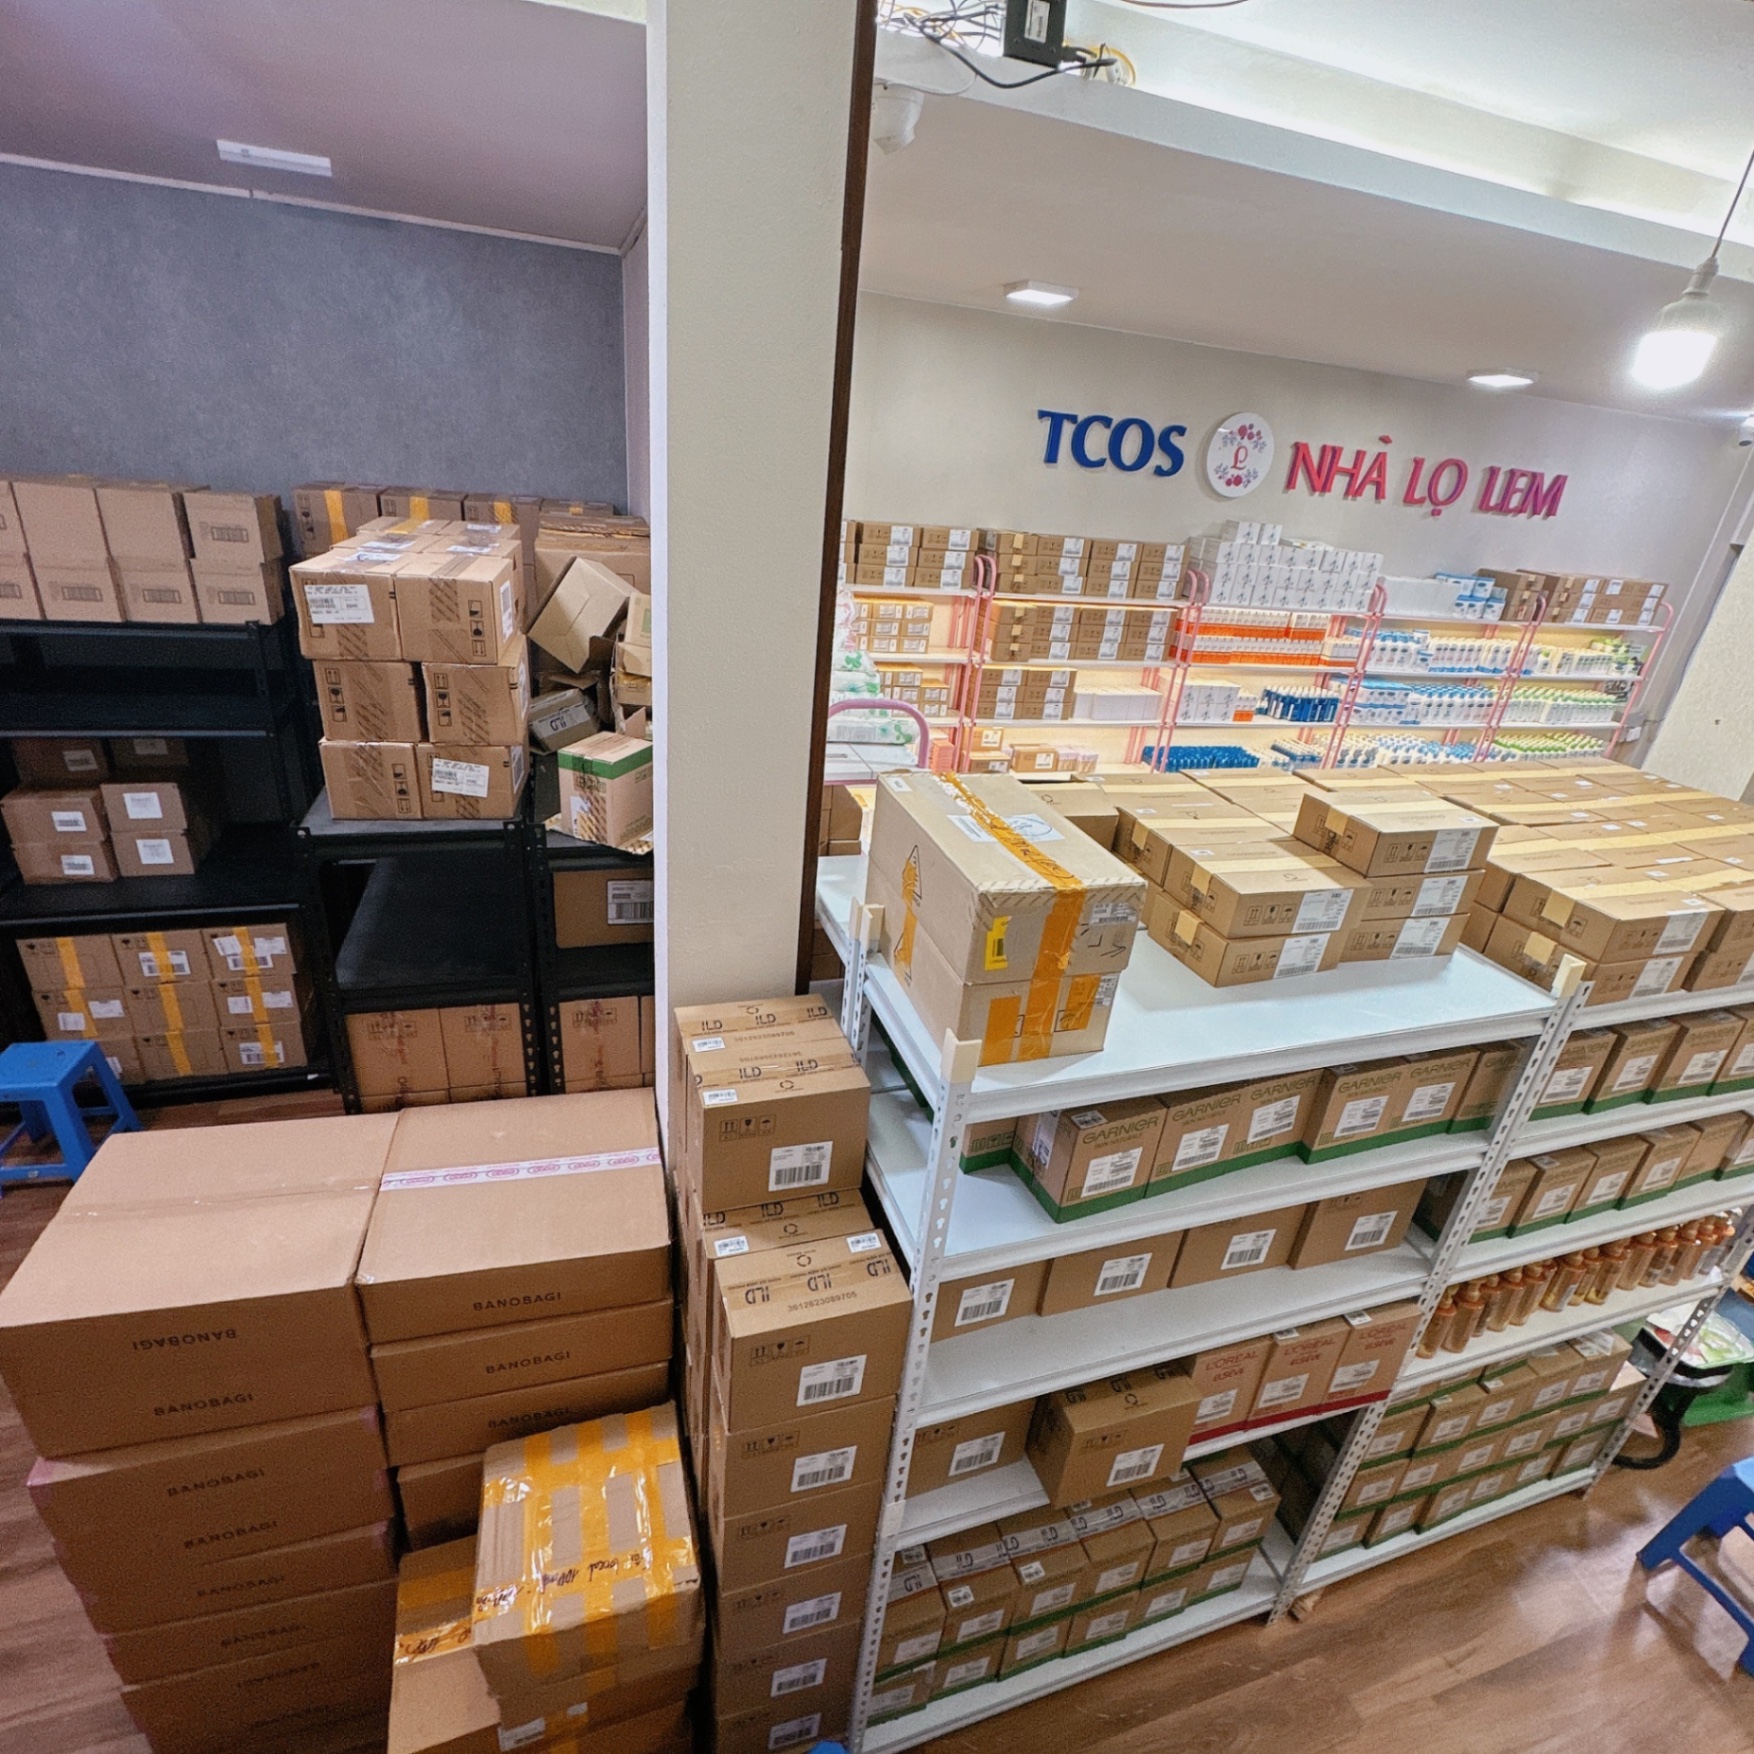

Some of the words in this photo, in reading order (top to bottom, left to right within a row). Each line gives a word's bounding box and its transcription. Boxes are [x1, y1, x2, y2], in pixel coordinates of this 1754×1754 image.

[1038, 409, 1187, 478] TCOS
[1286, 434, 1393, 500] NHÀ
[1404, 456, 1468, 517] LỌ
[1479, 465, 1568, 518] LEM
[755, 1013, 776, 1026] ILD
[806, 1006, 828, 1018] ILD
[701, 1019, 723, 1031] ILD
[739, 1066, 762, 1079] ILD
[1338, 1071, 1403, 1094] GARNIER
[1251, 1075, 1317, 1101] GARNIER
[1172, 1093, 1242, 1122] GARNIER
[1082, 1116, 1159, 1144] GARNIER
[867, 1259, 891, 1277] ILD
[807, 1273, 832, 1292] ILD
[473, 1291, 561, 1312] BANOBAGI
[744, 1286, 770, 1304] ILD
[133, 1328, 237, 1351] BANOBAGI
[486, 1351, 570, 1374] BANOBAGI
[153, 1393, 254, 1417] BANOBAGI
[167, 1468, 265, 1497] BANOBAGI
[184, 1520, 278, 1550] BANOBAGI
